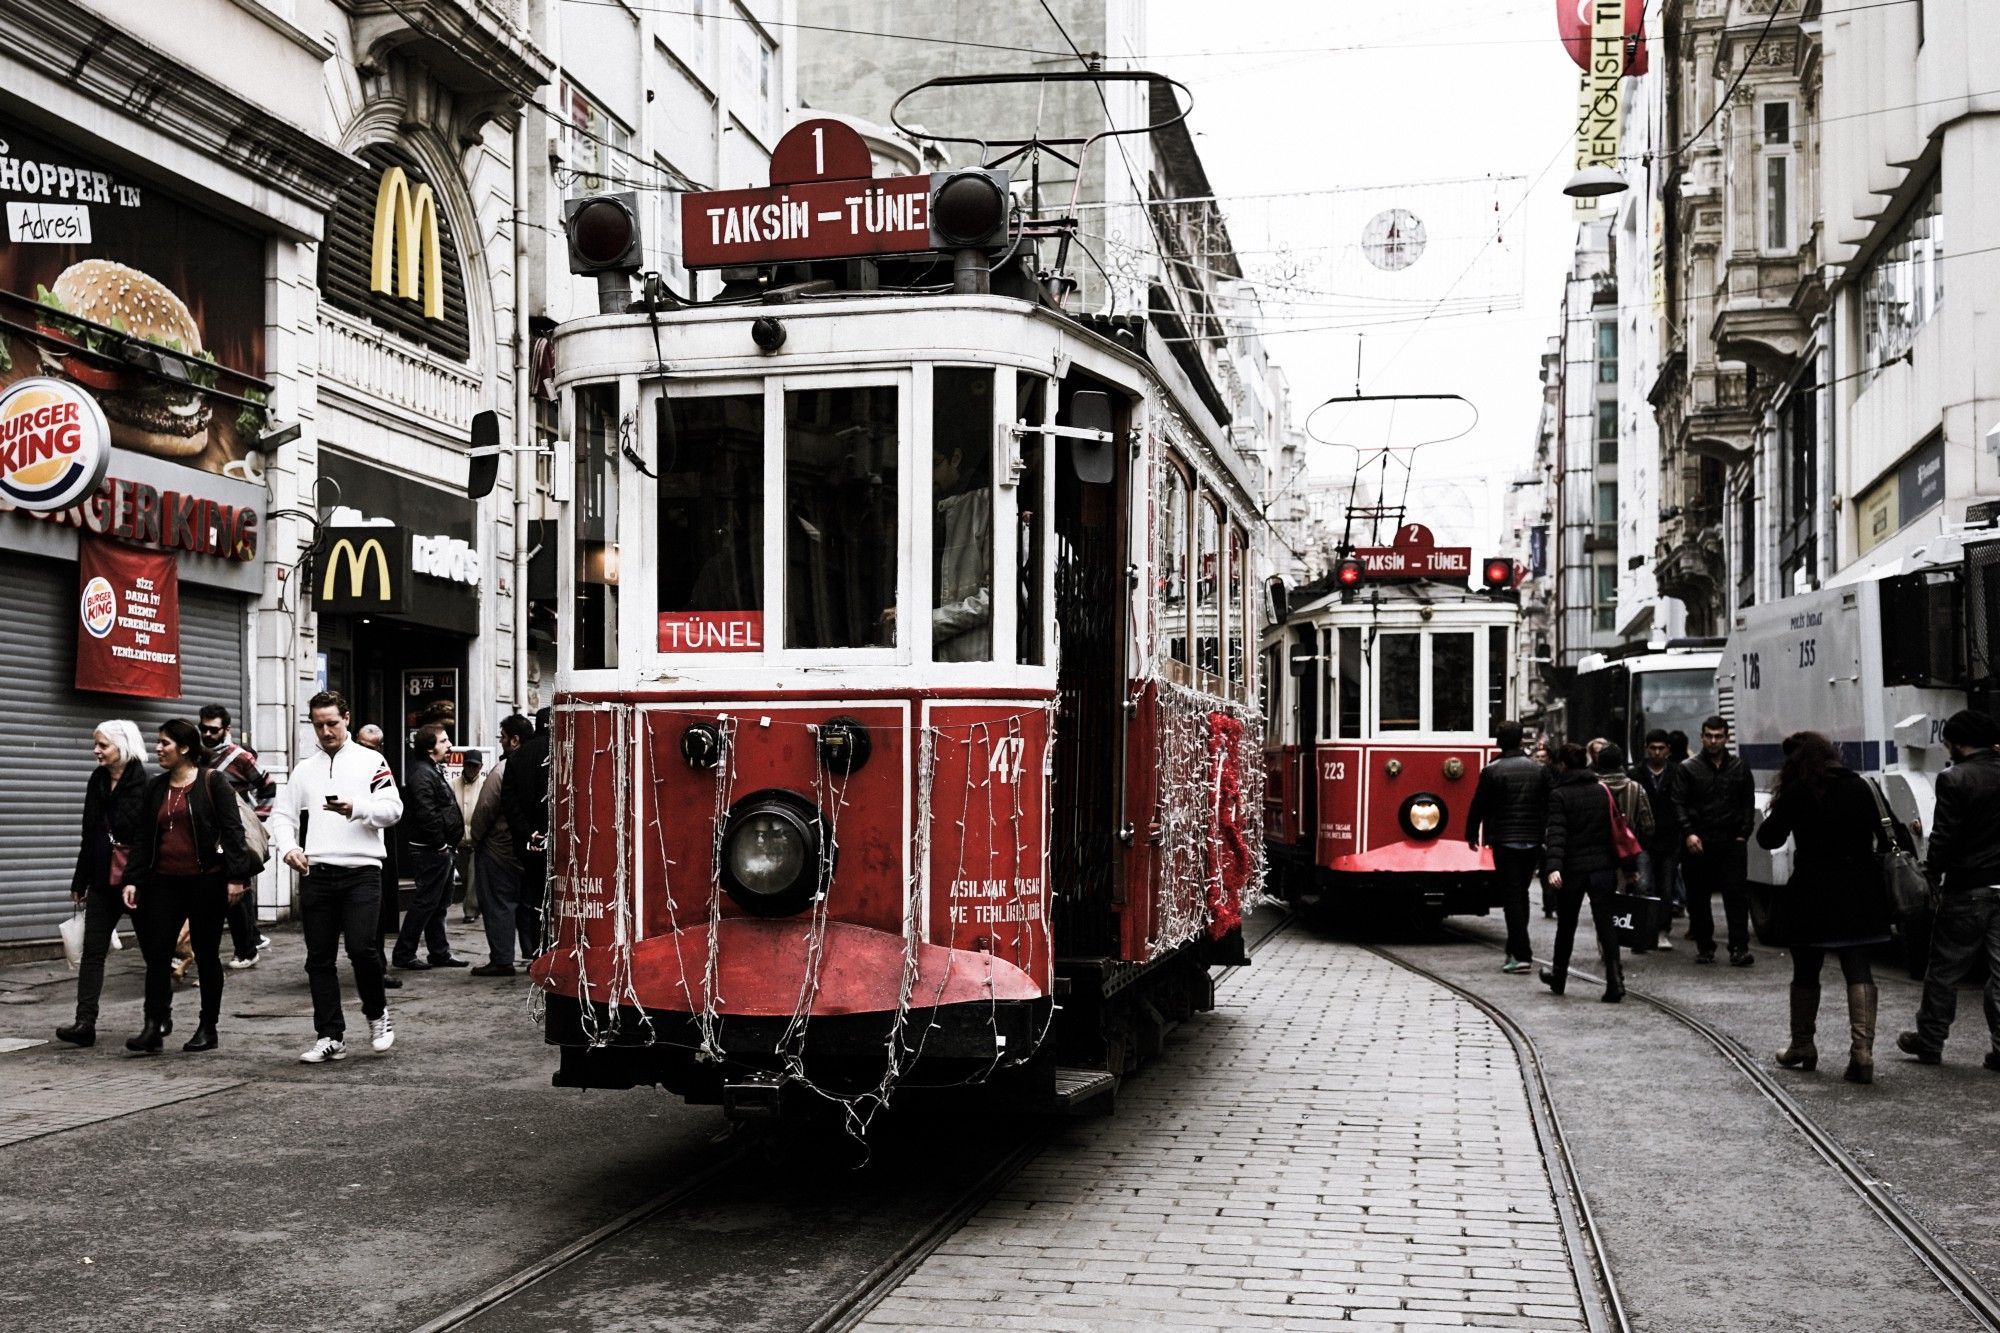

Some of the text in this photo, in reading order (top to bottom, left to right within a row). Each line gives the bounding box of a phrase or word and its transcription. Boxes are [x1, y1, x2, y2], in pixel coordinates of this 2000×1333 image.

[1592, 37, 1619, 155] ENGLISH
[811, 127, 824, 175] 1
[18, 203, 83, 242] Adresi
[706, 195, 809, 245] TAKSİM
[845, 188, 930, 235] TÜNE
[0, 423, 81, 478] KING
[162, 490, 258, 562] KING
[1409, 524, 1419, 543] 2
[1361, 552, 1405, 570] TAKSİM
[1426, 552, 1468, 570] TÜNEL
[87, 592, 111, 607] BURGER
[87, 601, 112, 621] KING
[125, 589, 149, 604] DAHA
[666, 617, 761, 648] TÜNEL
[1799, 639, 1816, 669] 155
[989, 737, 1025, 784] 47
[1324, 762, 1345, 780] 223
[950, 879, 1007, 898] ASILMAK
